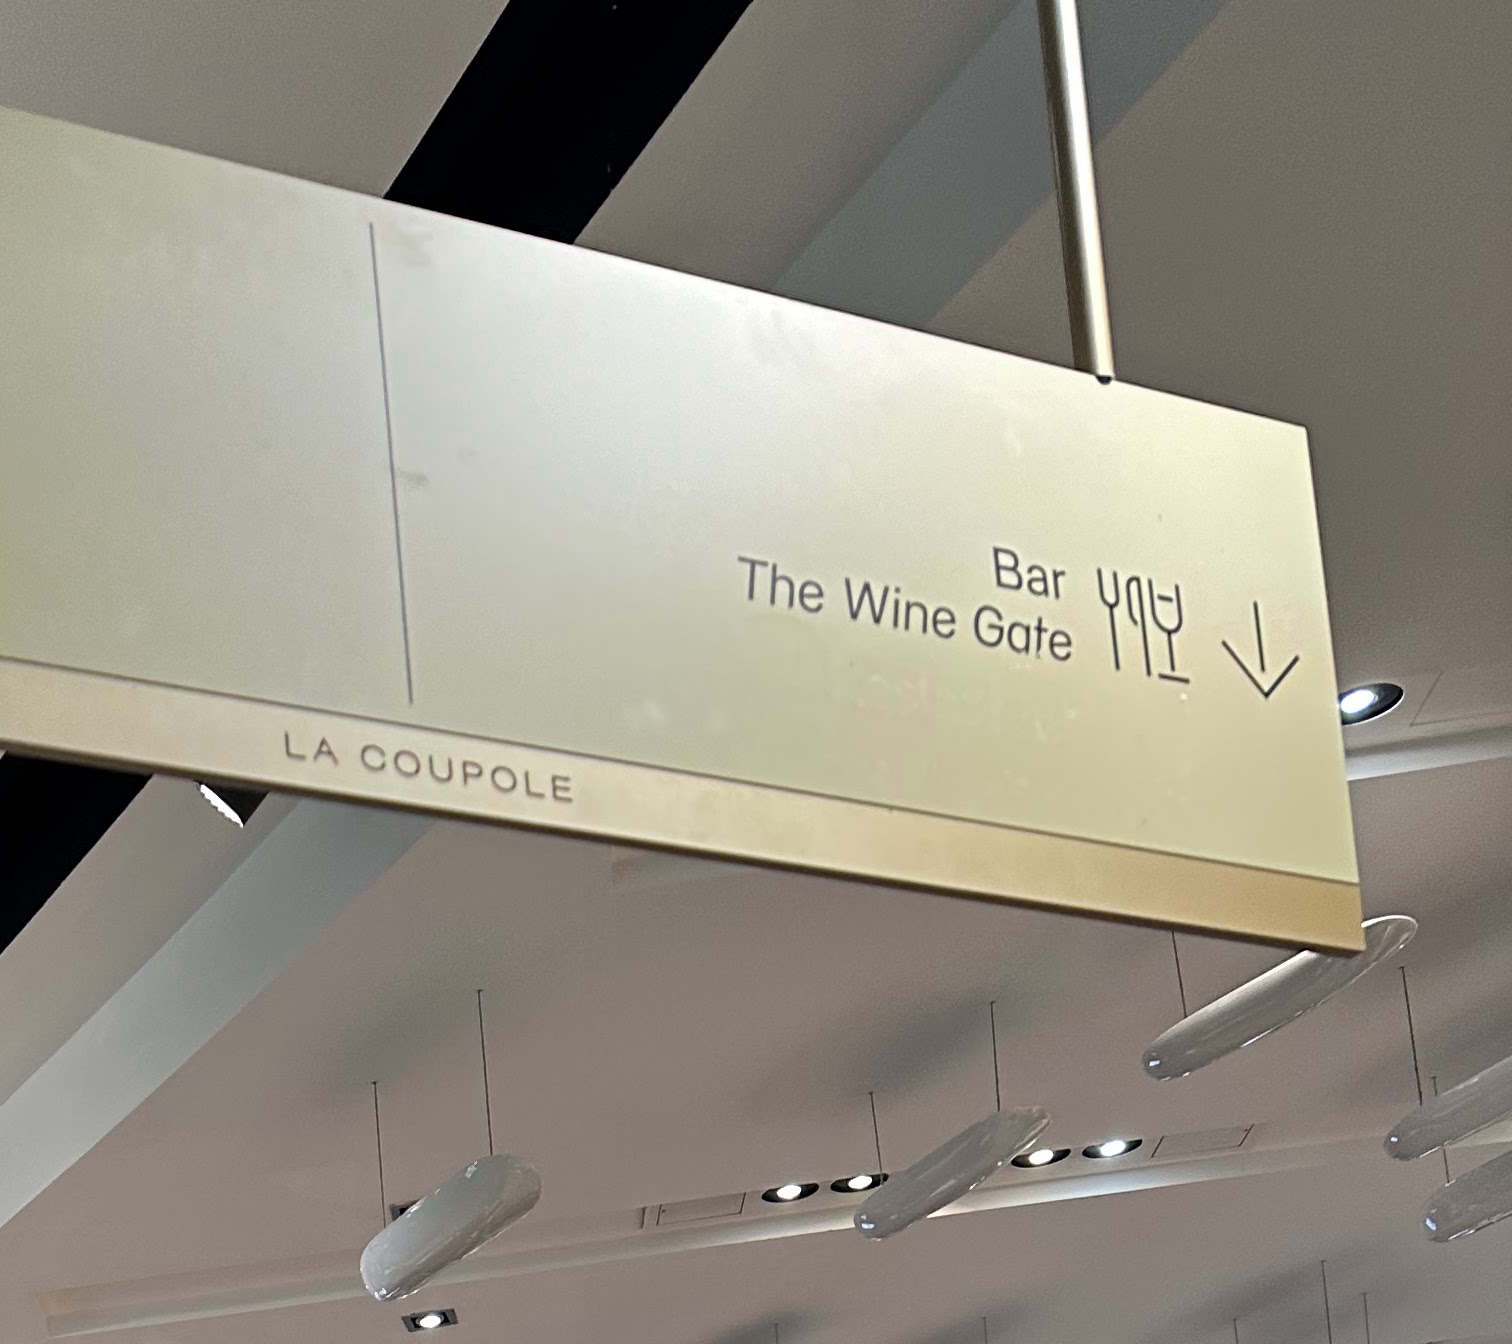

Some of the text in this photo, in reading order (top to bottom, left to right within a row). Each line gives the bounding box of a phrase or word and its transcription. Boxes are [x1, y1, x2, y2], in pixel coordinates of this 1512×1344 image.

[738, 555, 1073, 662] The Wine Gate
[992, 546, 1066, 601] Bar
[284, 731, 572, 803] LA COUPOLE
